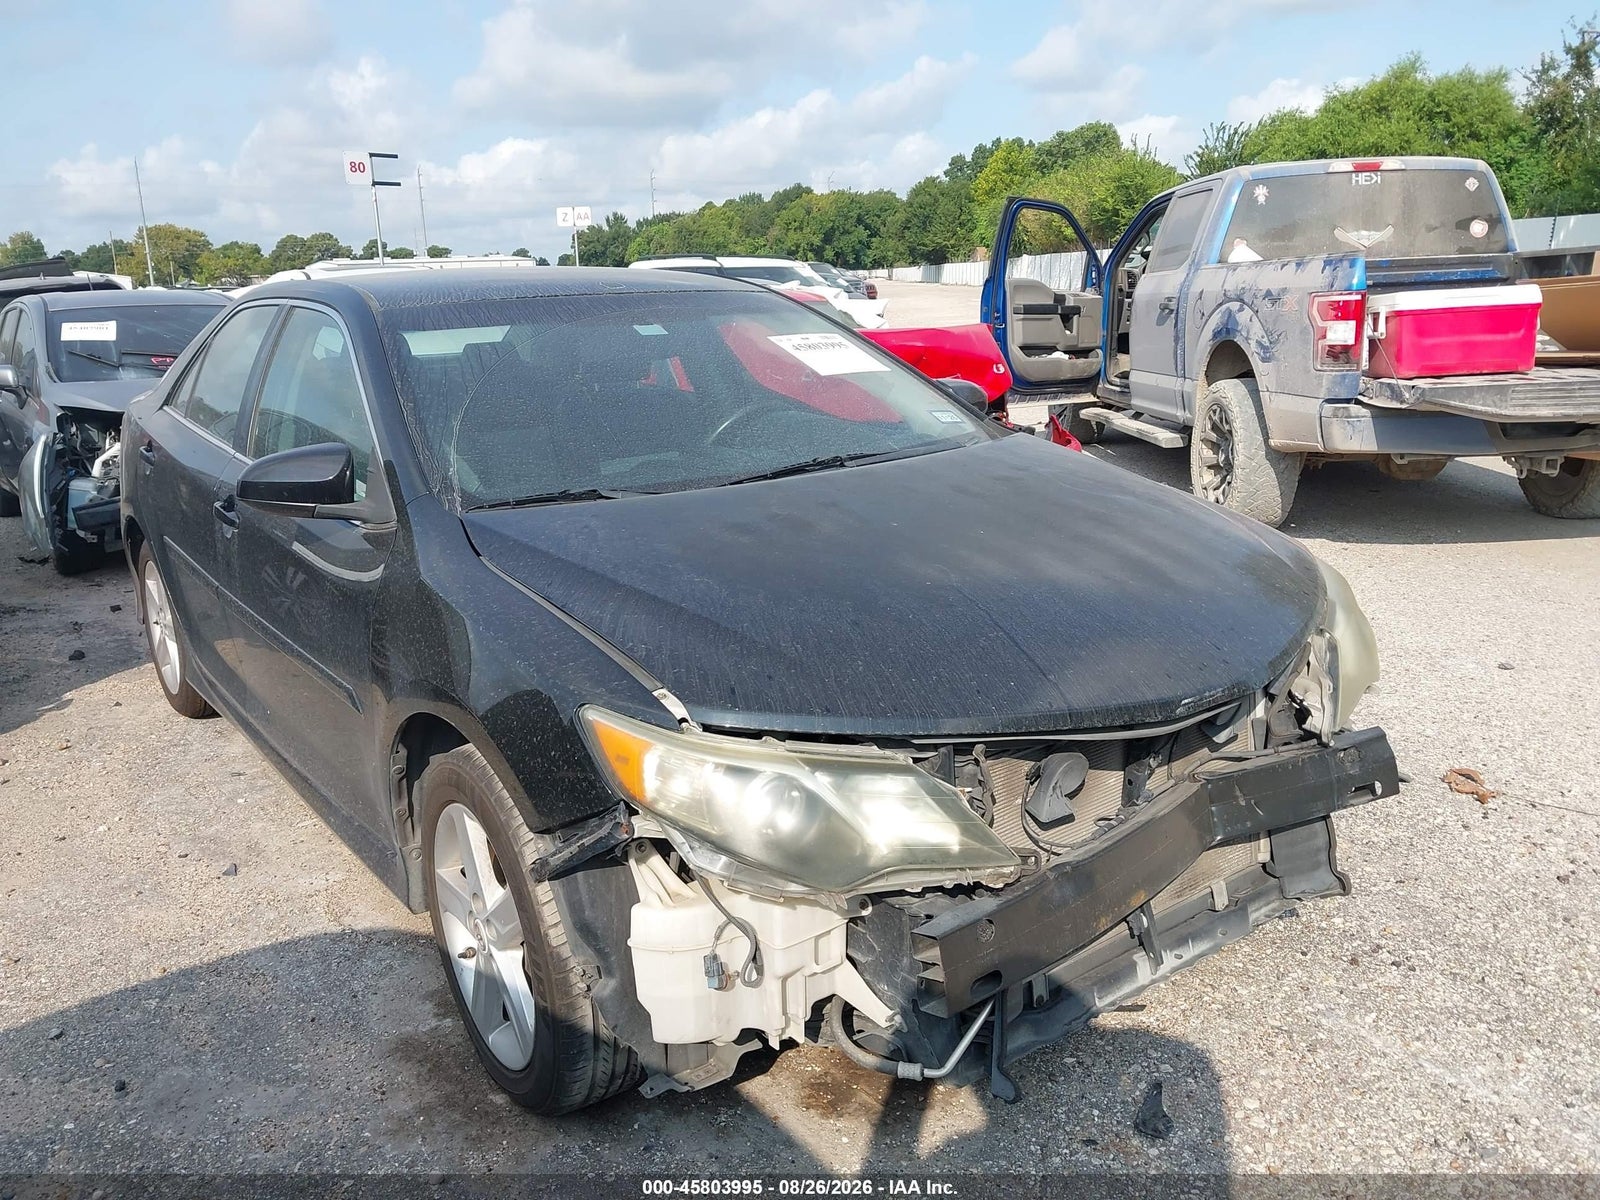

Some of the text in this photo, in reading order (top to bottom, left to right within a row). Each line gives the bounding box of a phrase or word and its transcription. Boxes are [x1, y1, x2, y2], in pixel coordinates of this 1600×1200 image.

[349, 161, 366, 173] 80
[561, 212, 569, 222] Z
[576, 212, 590, 221] AA
